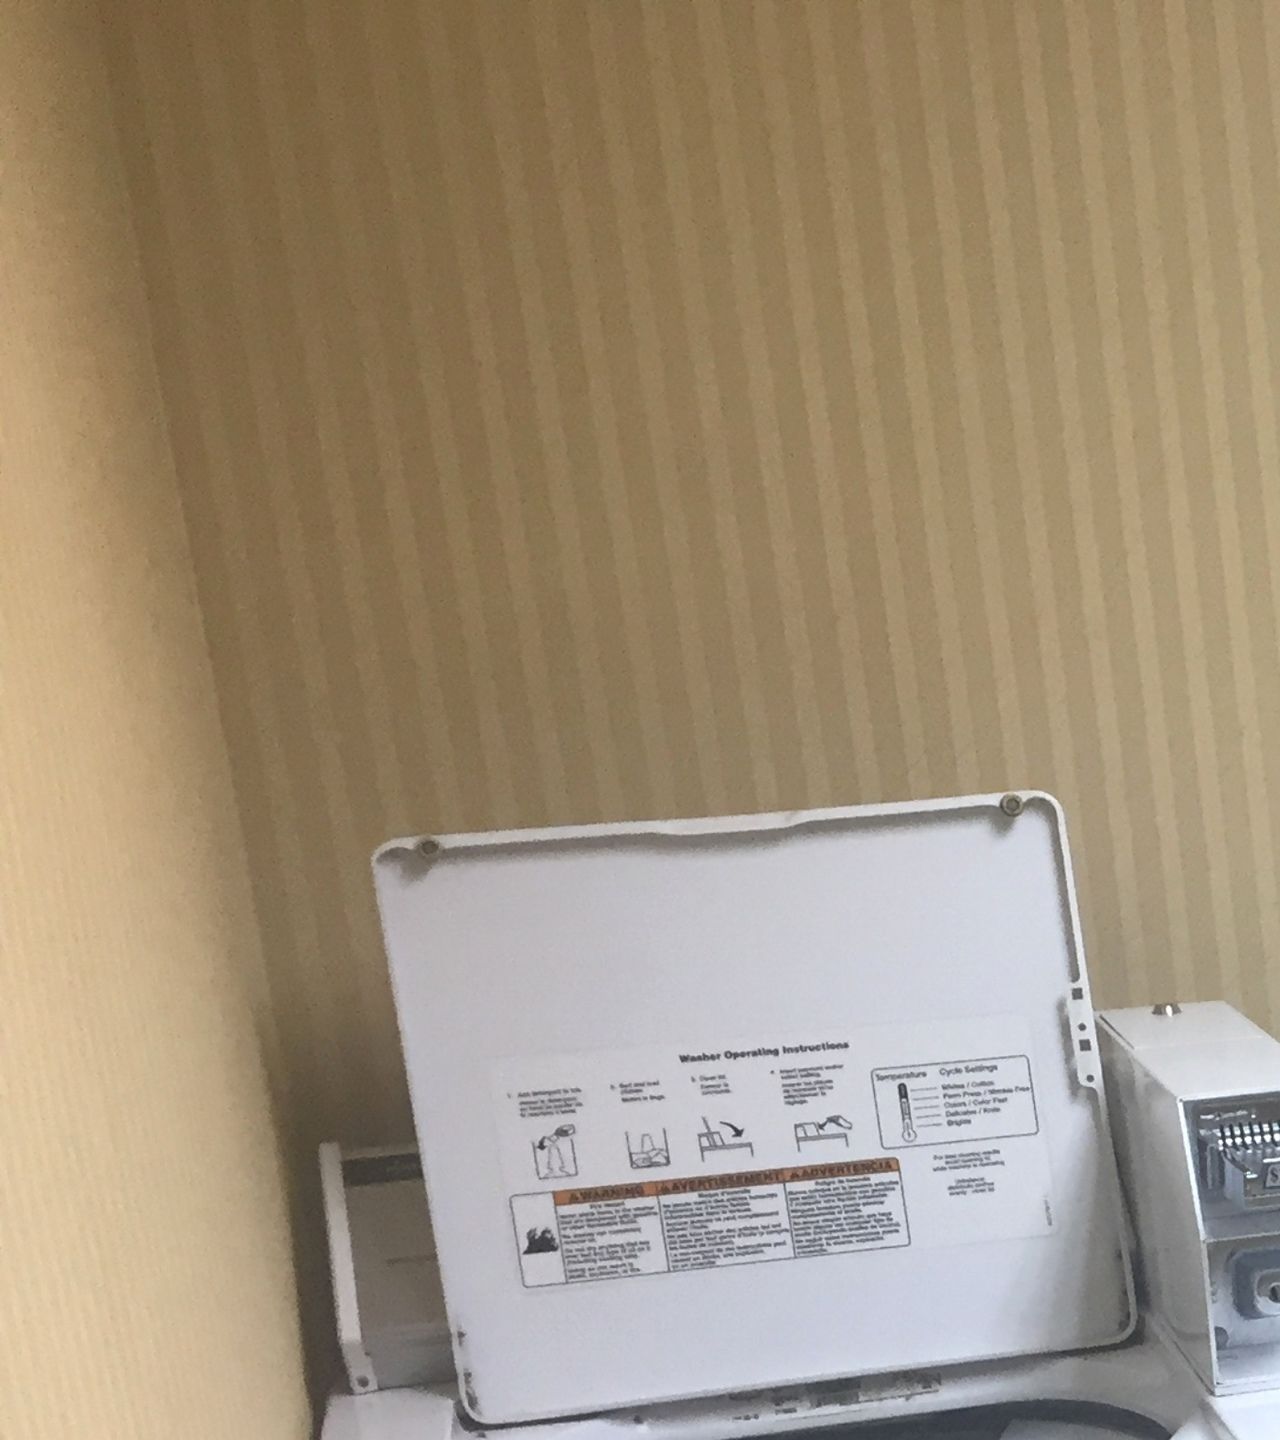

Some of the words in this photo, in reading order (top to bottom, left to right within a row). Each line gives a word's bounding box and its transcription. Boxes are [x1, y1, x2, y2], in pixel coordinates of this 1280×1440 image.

[678, 1052, 721, 1063] Washer
[724, 1047, 780, 1060] Operating
[782, 1041, 850, 1055] Instructions
[939, 1067, 963, 1077] Cycle
[965, 1064, 998, 1074] Settings
